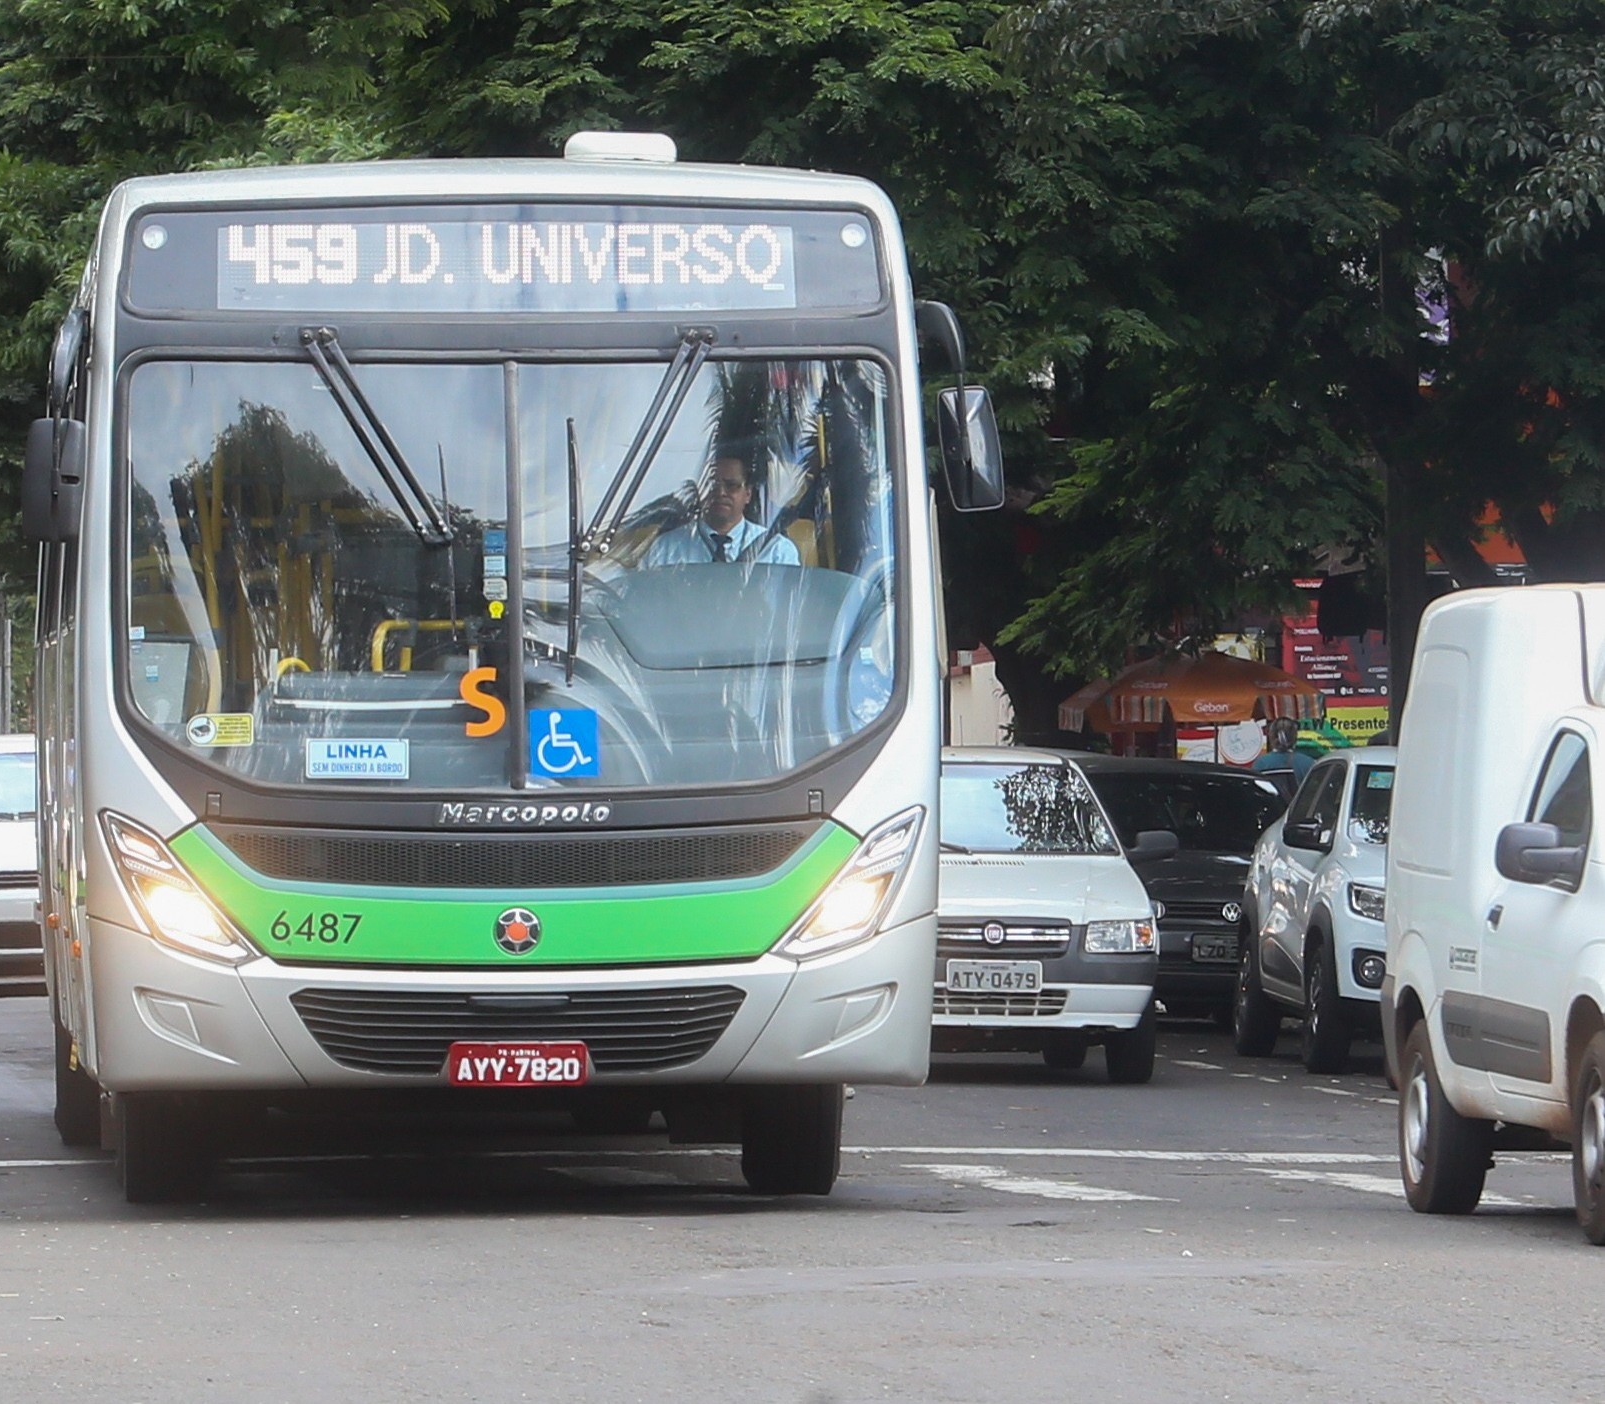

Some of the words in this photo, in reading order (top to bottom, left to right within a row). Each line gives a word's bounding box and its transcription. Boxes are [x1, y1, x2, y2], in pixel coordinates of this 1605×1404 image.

[227, 223, 357, 284] 459
[372, 224, 454, 284] JD.
[482, 224, 782, 284] UNIVERSO
[459, 666, 506, 737] S
[326, 744, 388, 759] LINHA
[312, 762, 329, 773] SEM
[331, 762, 367, 773] DINHEIRO
[369, 762, 375, 773] A
[377, 762, 403, 774] BORDO
[439, 802, 610, 826] Marcopolo
[270, 910, 362, 944] 6487
